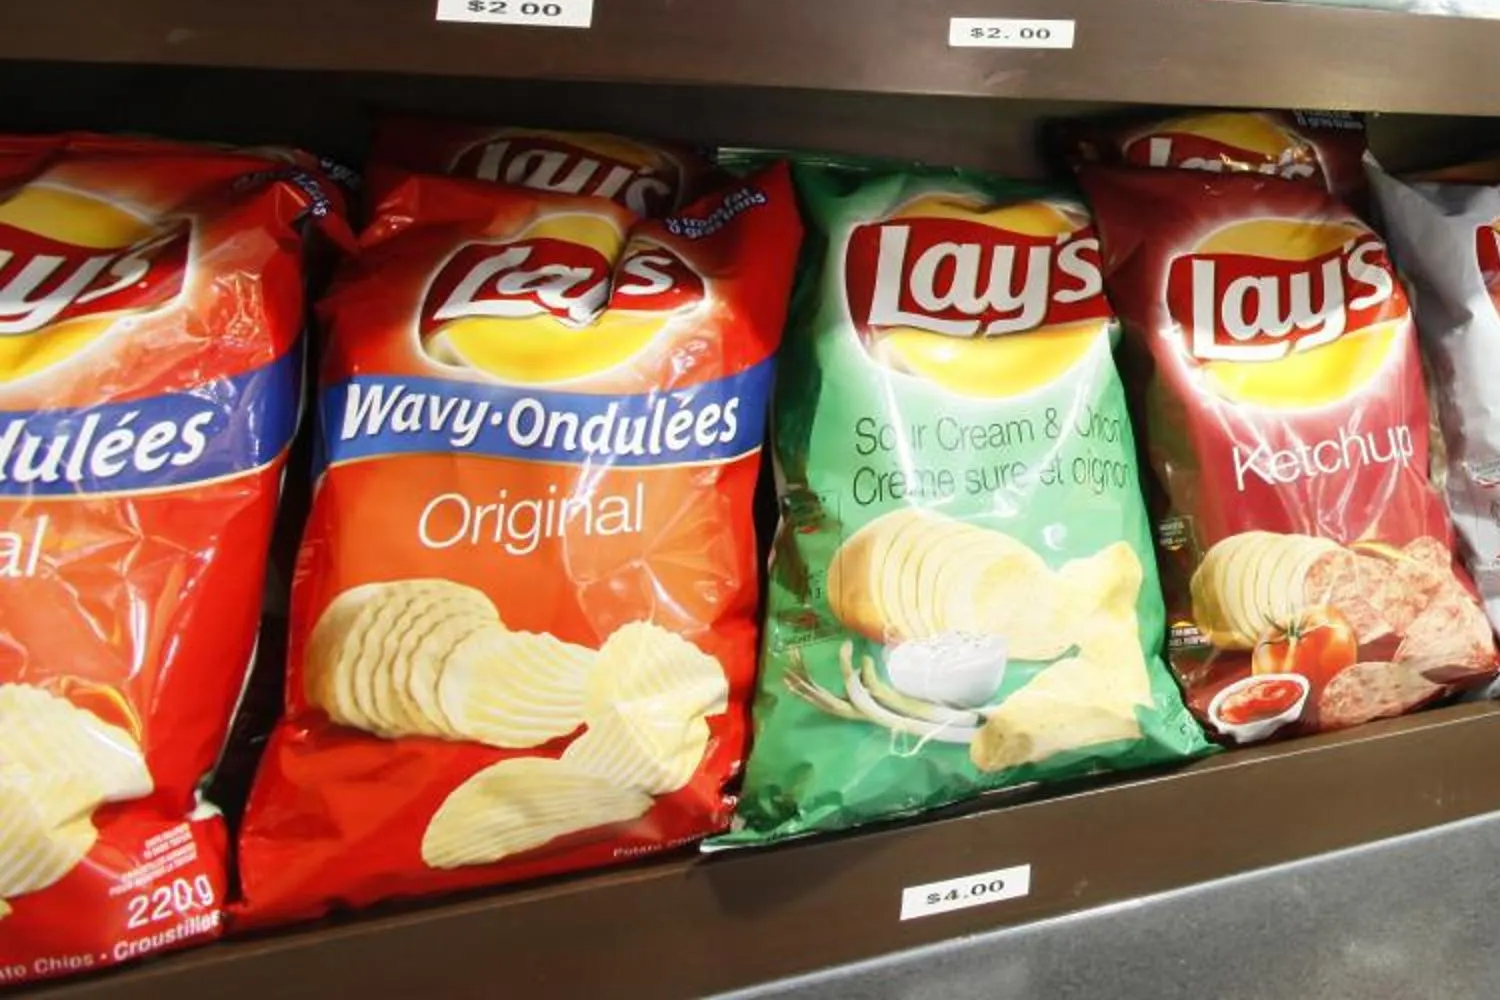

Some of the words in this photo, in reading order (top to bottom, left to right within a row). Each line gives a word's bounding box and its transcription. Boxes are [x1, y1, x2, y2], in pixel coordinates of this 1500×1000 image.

[467, 0, 562, 17] $200
[970, 26, 1052, 41] $2.00
[868, 225, 1103, 338] Lay's
[1192, 238, 1393, 362] Lay's
[341, 383, 490, 446] Wavy
[507, 389, 740, 457] Ondulées
[936, 415, 1035, 451] Cream
[1045, 407, 1062, 439] &
[965, 459, 1032, 496] sure
[1039, 455, 1064, 486] et
[1232, 426, 1414, 491] Ketchup
[418, 482, 645, 557] Original
[127, 873, 215, 930] 220g
[926, 880, 1005, 904] $4.00
[34, 952, 94, 975] Chips
